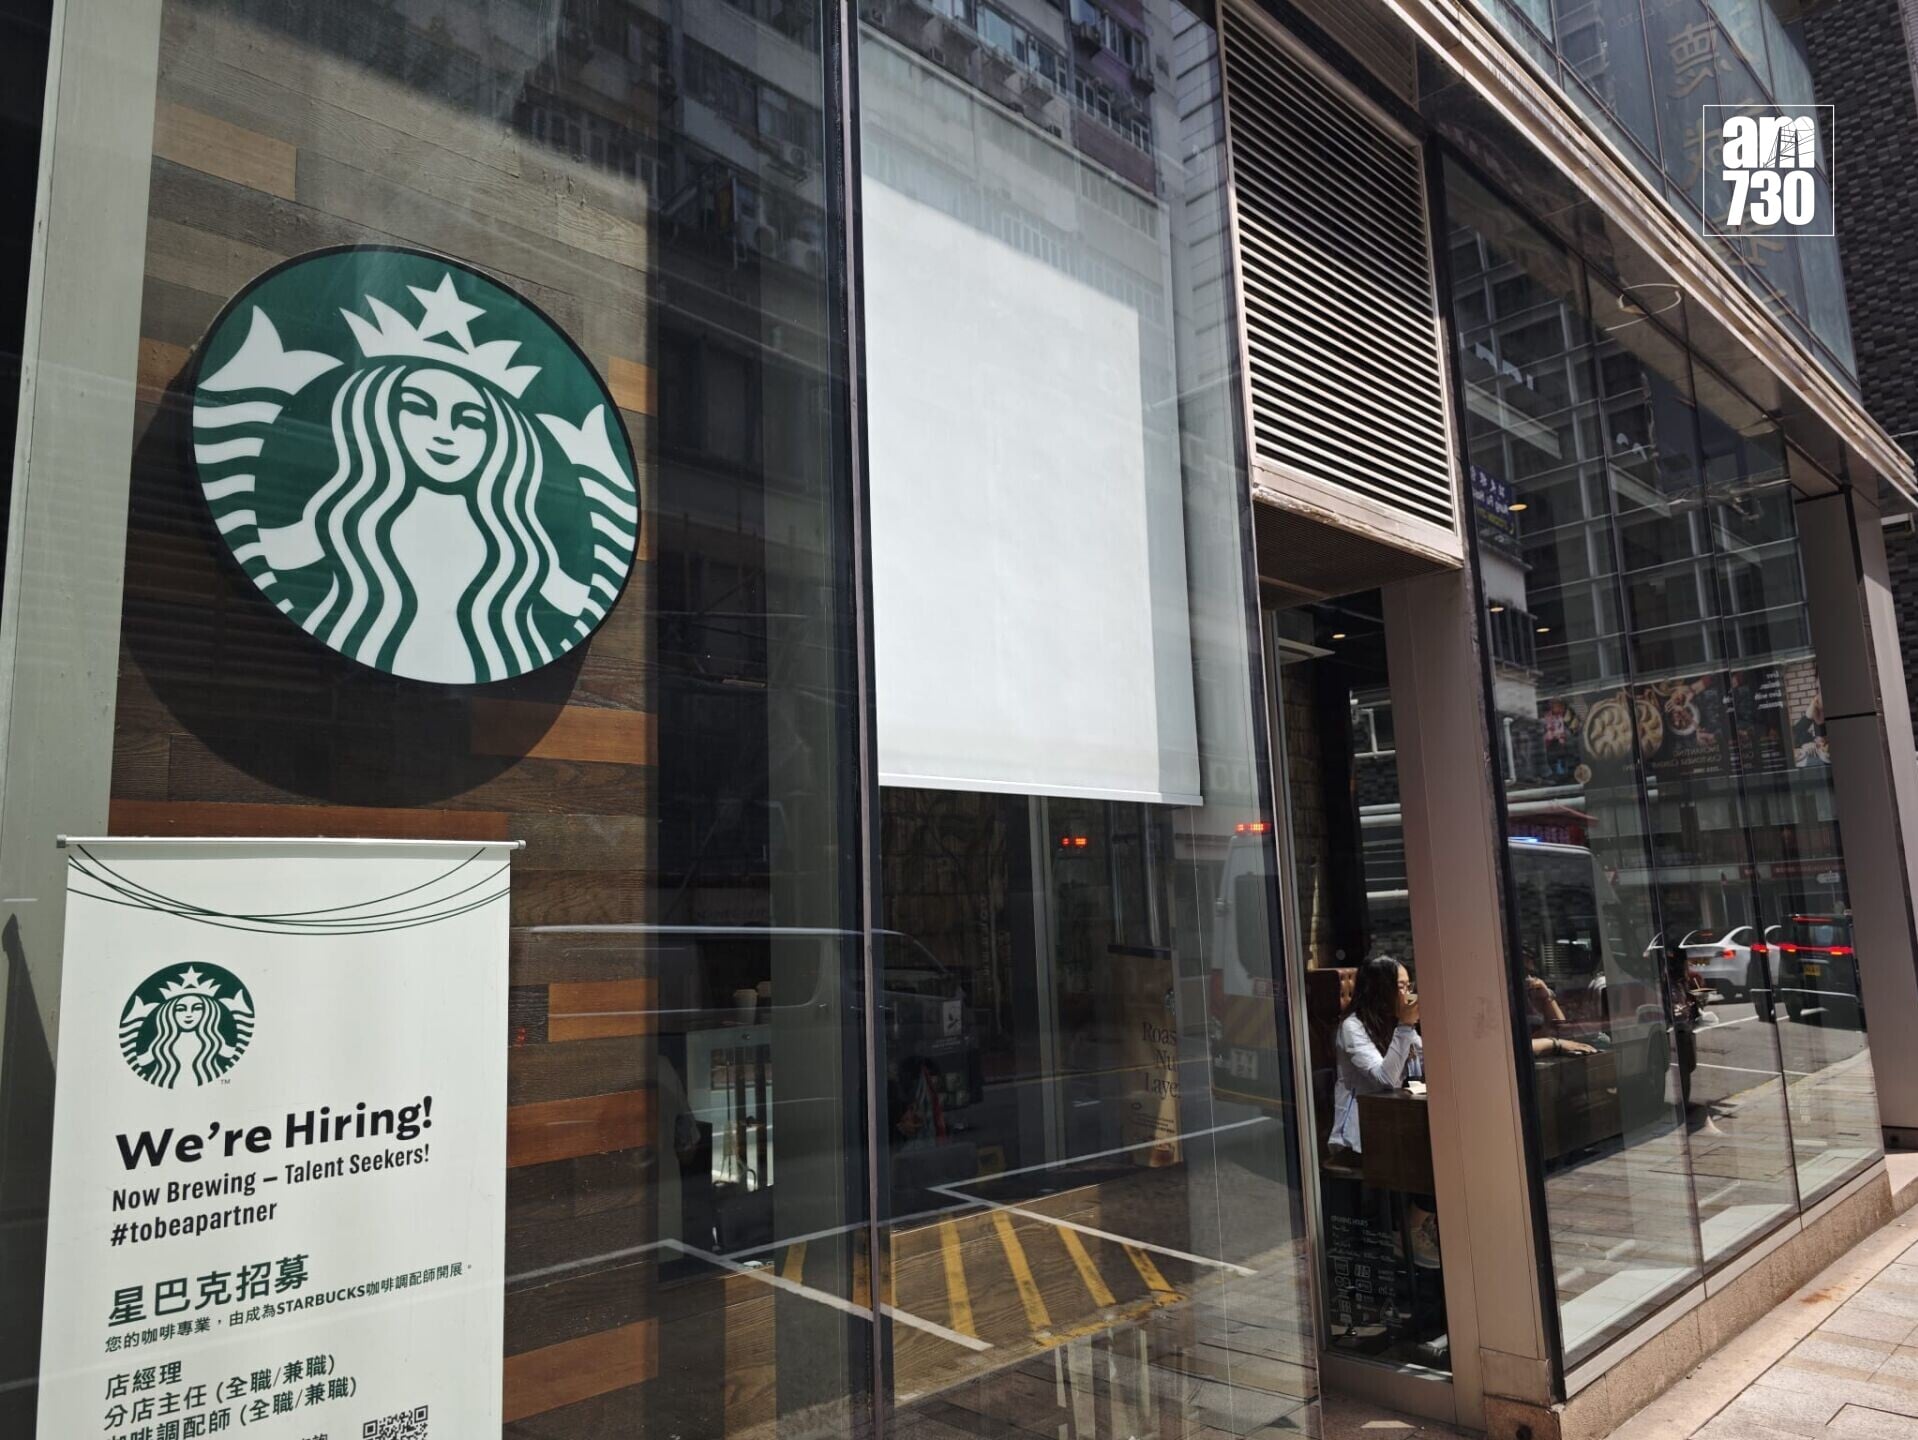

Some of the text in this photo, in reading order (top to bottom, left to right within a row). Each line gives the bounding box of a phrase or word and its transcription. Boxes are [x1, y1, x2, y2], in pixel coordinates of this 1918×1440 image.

[1144, 1071, 1182, 1100] Laye
[115, 1095, 433, 1170] We’re Hiring!
[112, 1187, 160, 1211] Now
[167, 1172, 256, 1203] Brewing
[285, 1157, 344, 1184] Talent
[349, 1143, 430, 1174] Seekers!
[110, 1201, 278, 1247] #tobeapartner
[108, 1254, 309, 1327] 星巴克招募
[103, 1354, 336, 1431] 分店主任 (全職/兼職)
[105, 1361, 183, 1400] 店經理
[240, 1376, 357, 1427] (全職/兼職)
